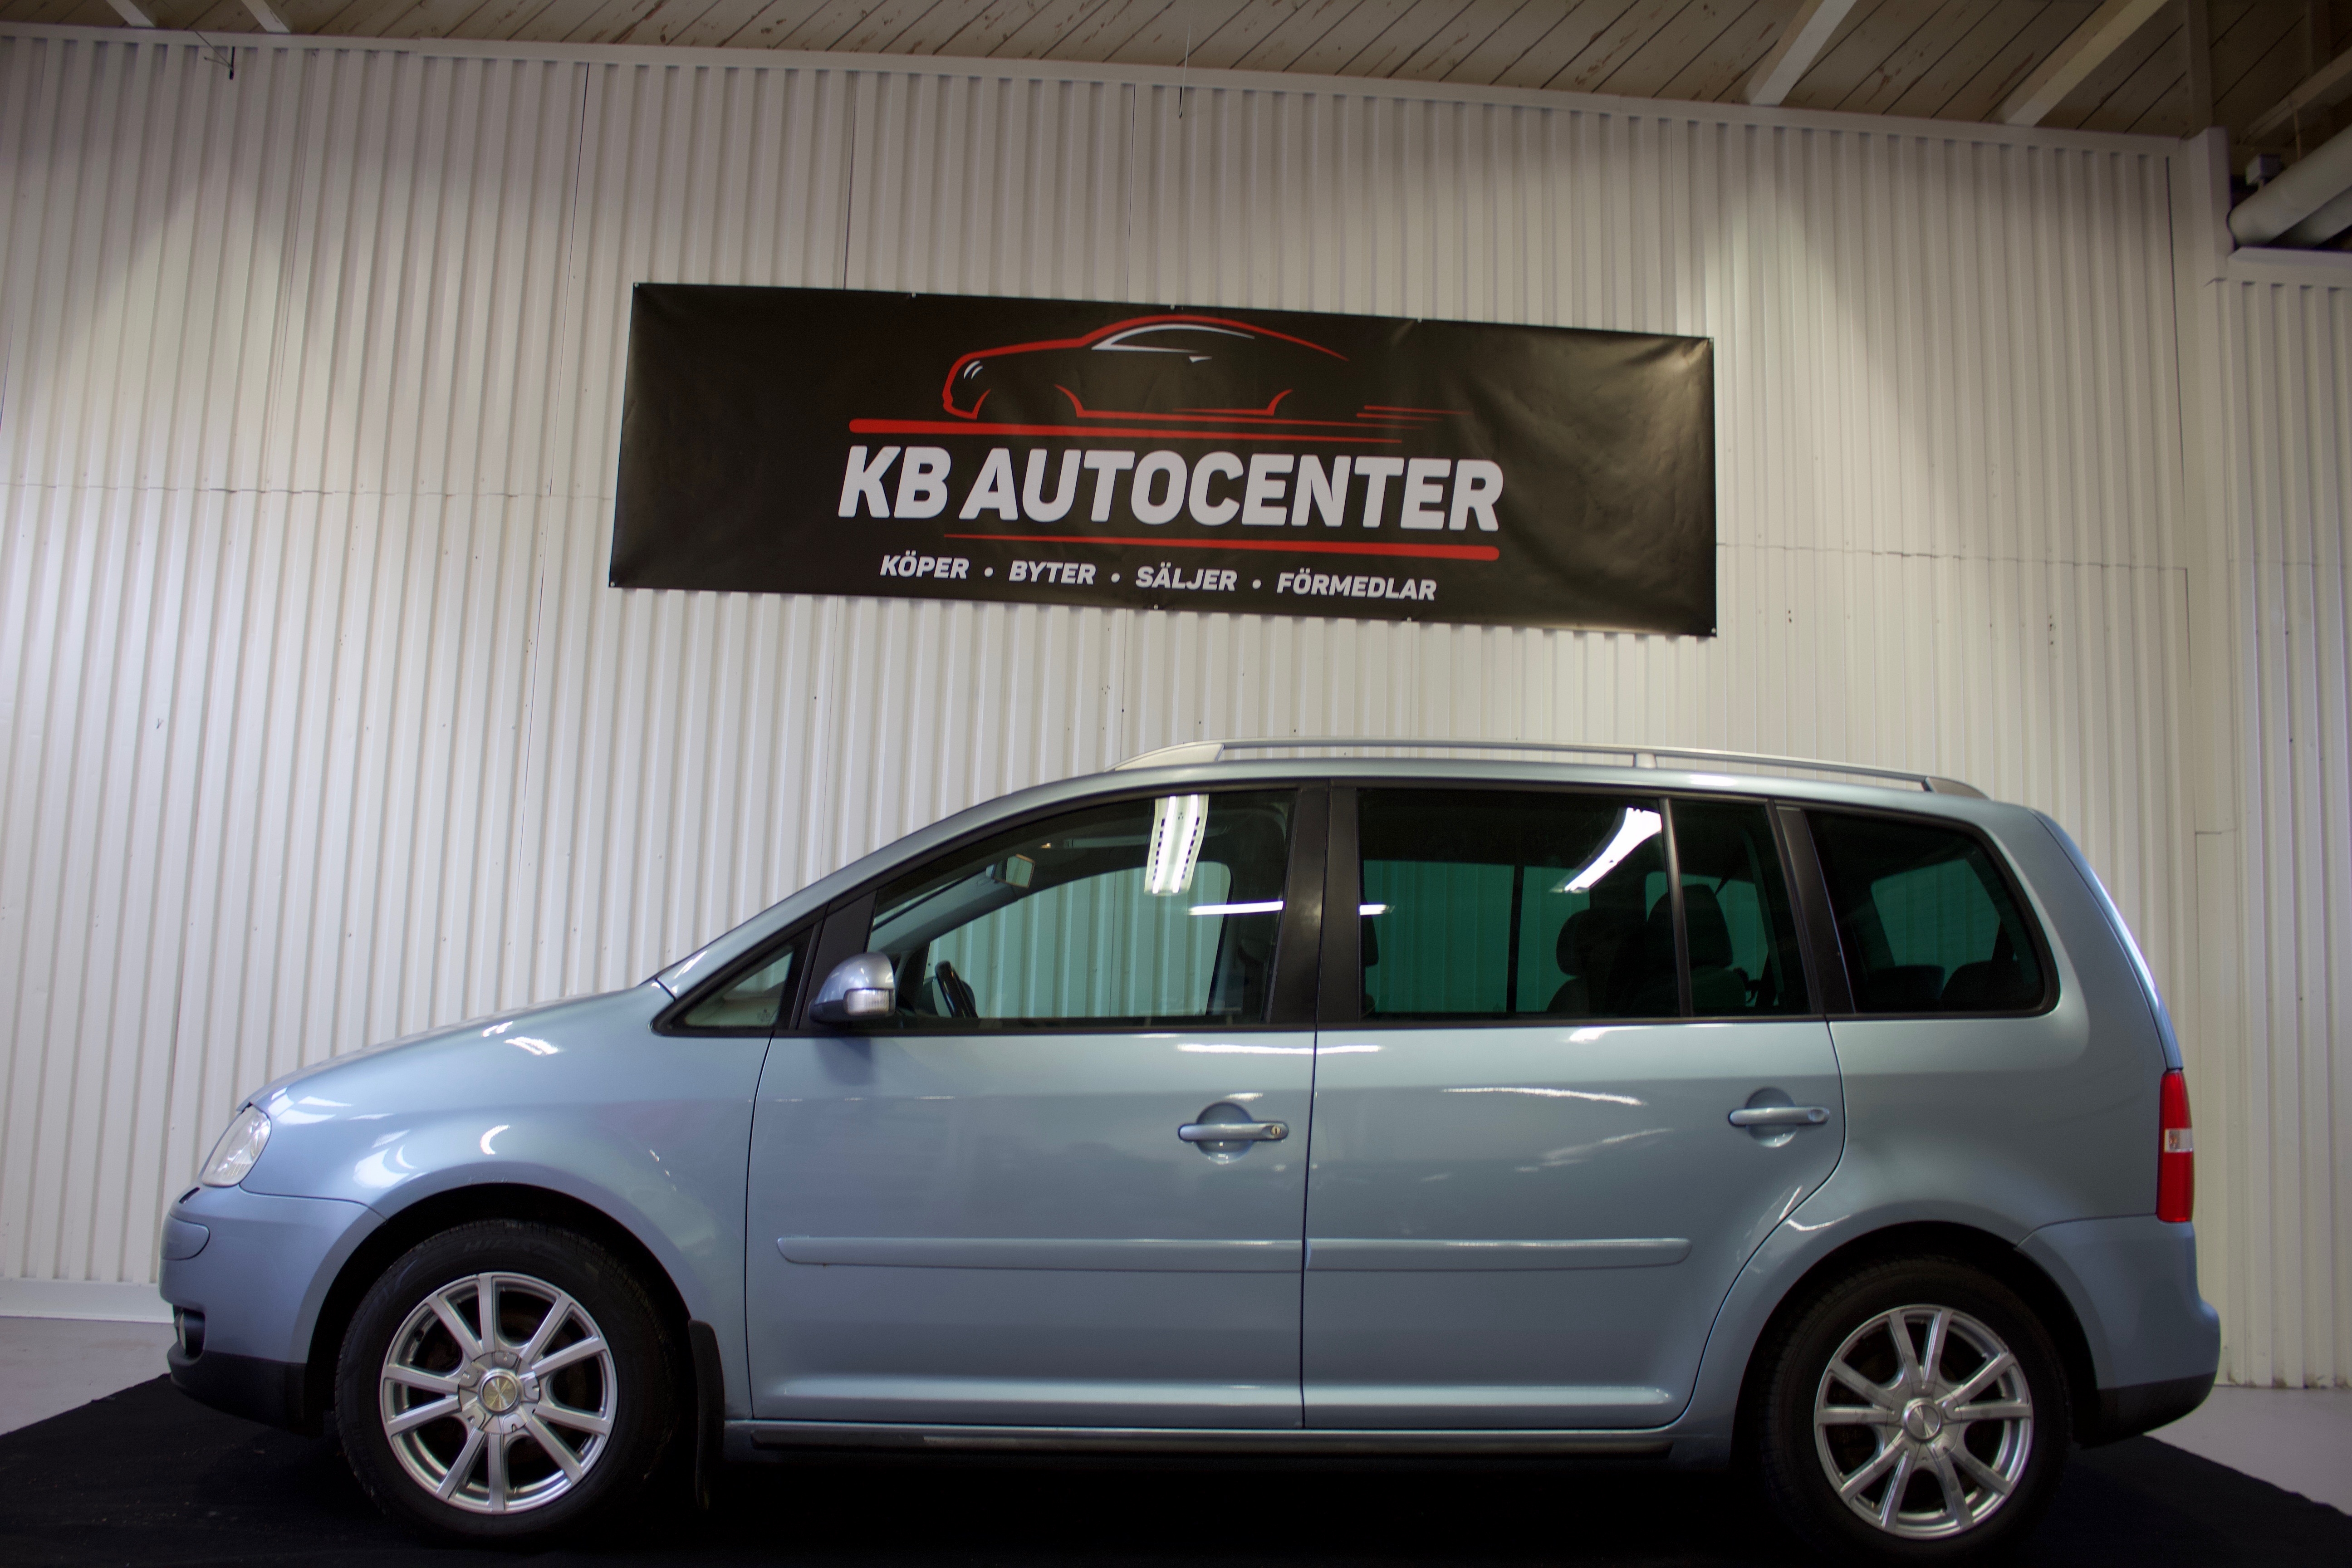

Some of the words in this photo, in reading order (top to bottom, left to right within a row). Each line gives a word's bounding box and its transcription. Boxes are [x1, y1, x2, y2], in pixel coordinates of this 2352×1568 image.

[838, 446, 951, 518] KB
[959, 448, 1504, 531] AUTOCENTER
[880, 550, 969, 579] KÖPER
[1008, 560, 1096, 584] BYTER
[1136, 562, 1237, 591] SÄLJER
[1277, 568, 1437, 600] FÖRMEDLAR
